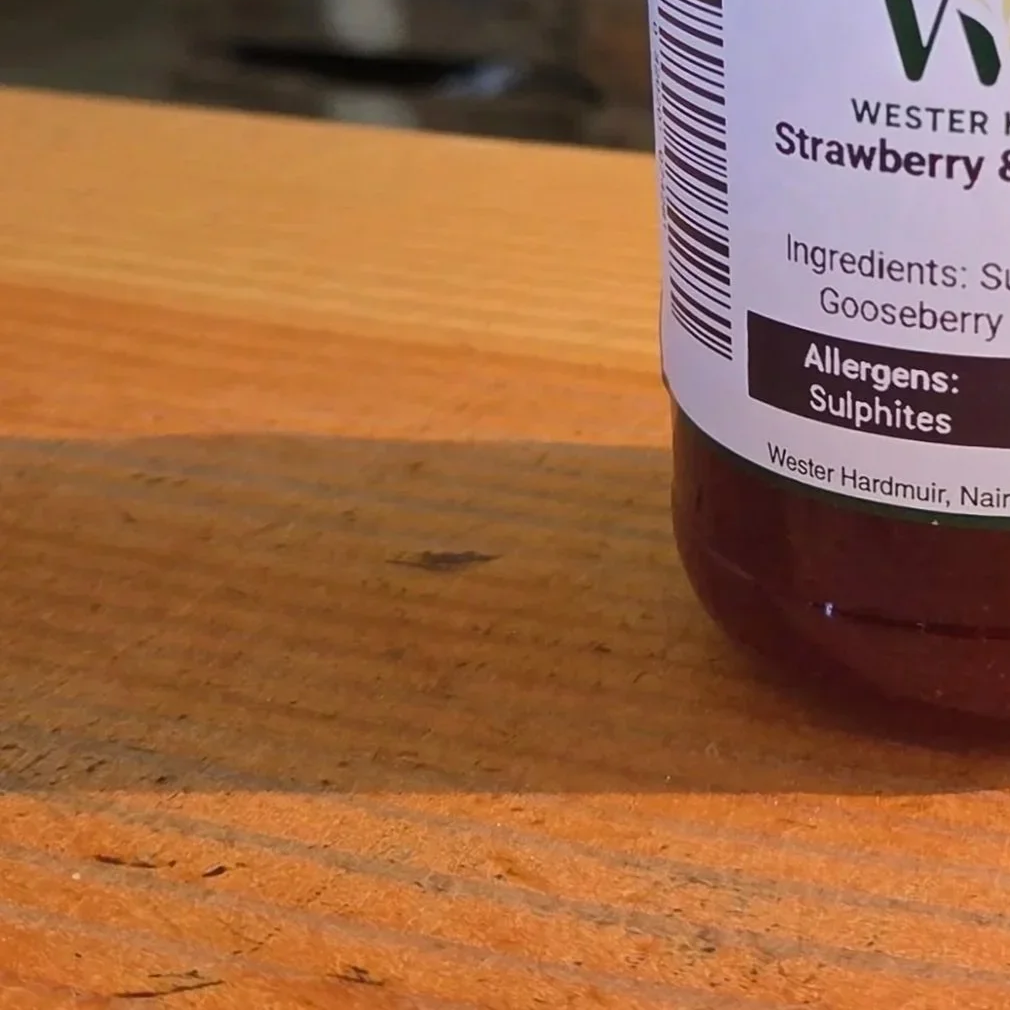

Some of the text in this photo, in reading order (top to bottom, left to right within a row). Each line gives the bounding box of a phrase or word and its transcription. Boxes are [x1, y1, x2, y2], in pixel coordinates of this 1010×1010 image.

[851, 98, 988, 135] WESTER
[775, 121, 984, 190] Strawberry
[788, 234, 966, 288] Ingredients:
[820, 287, 1003, 342] Gooseberry
[805, 343, 958, 393] Allergens:
[809, 385, 953, 434] Sulphites
[766, 442, 835, 482] Wester
[841, 466, 950, 507] Hardmuir,
